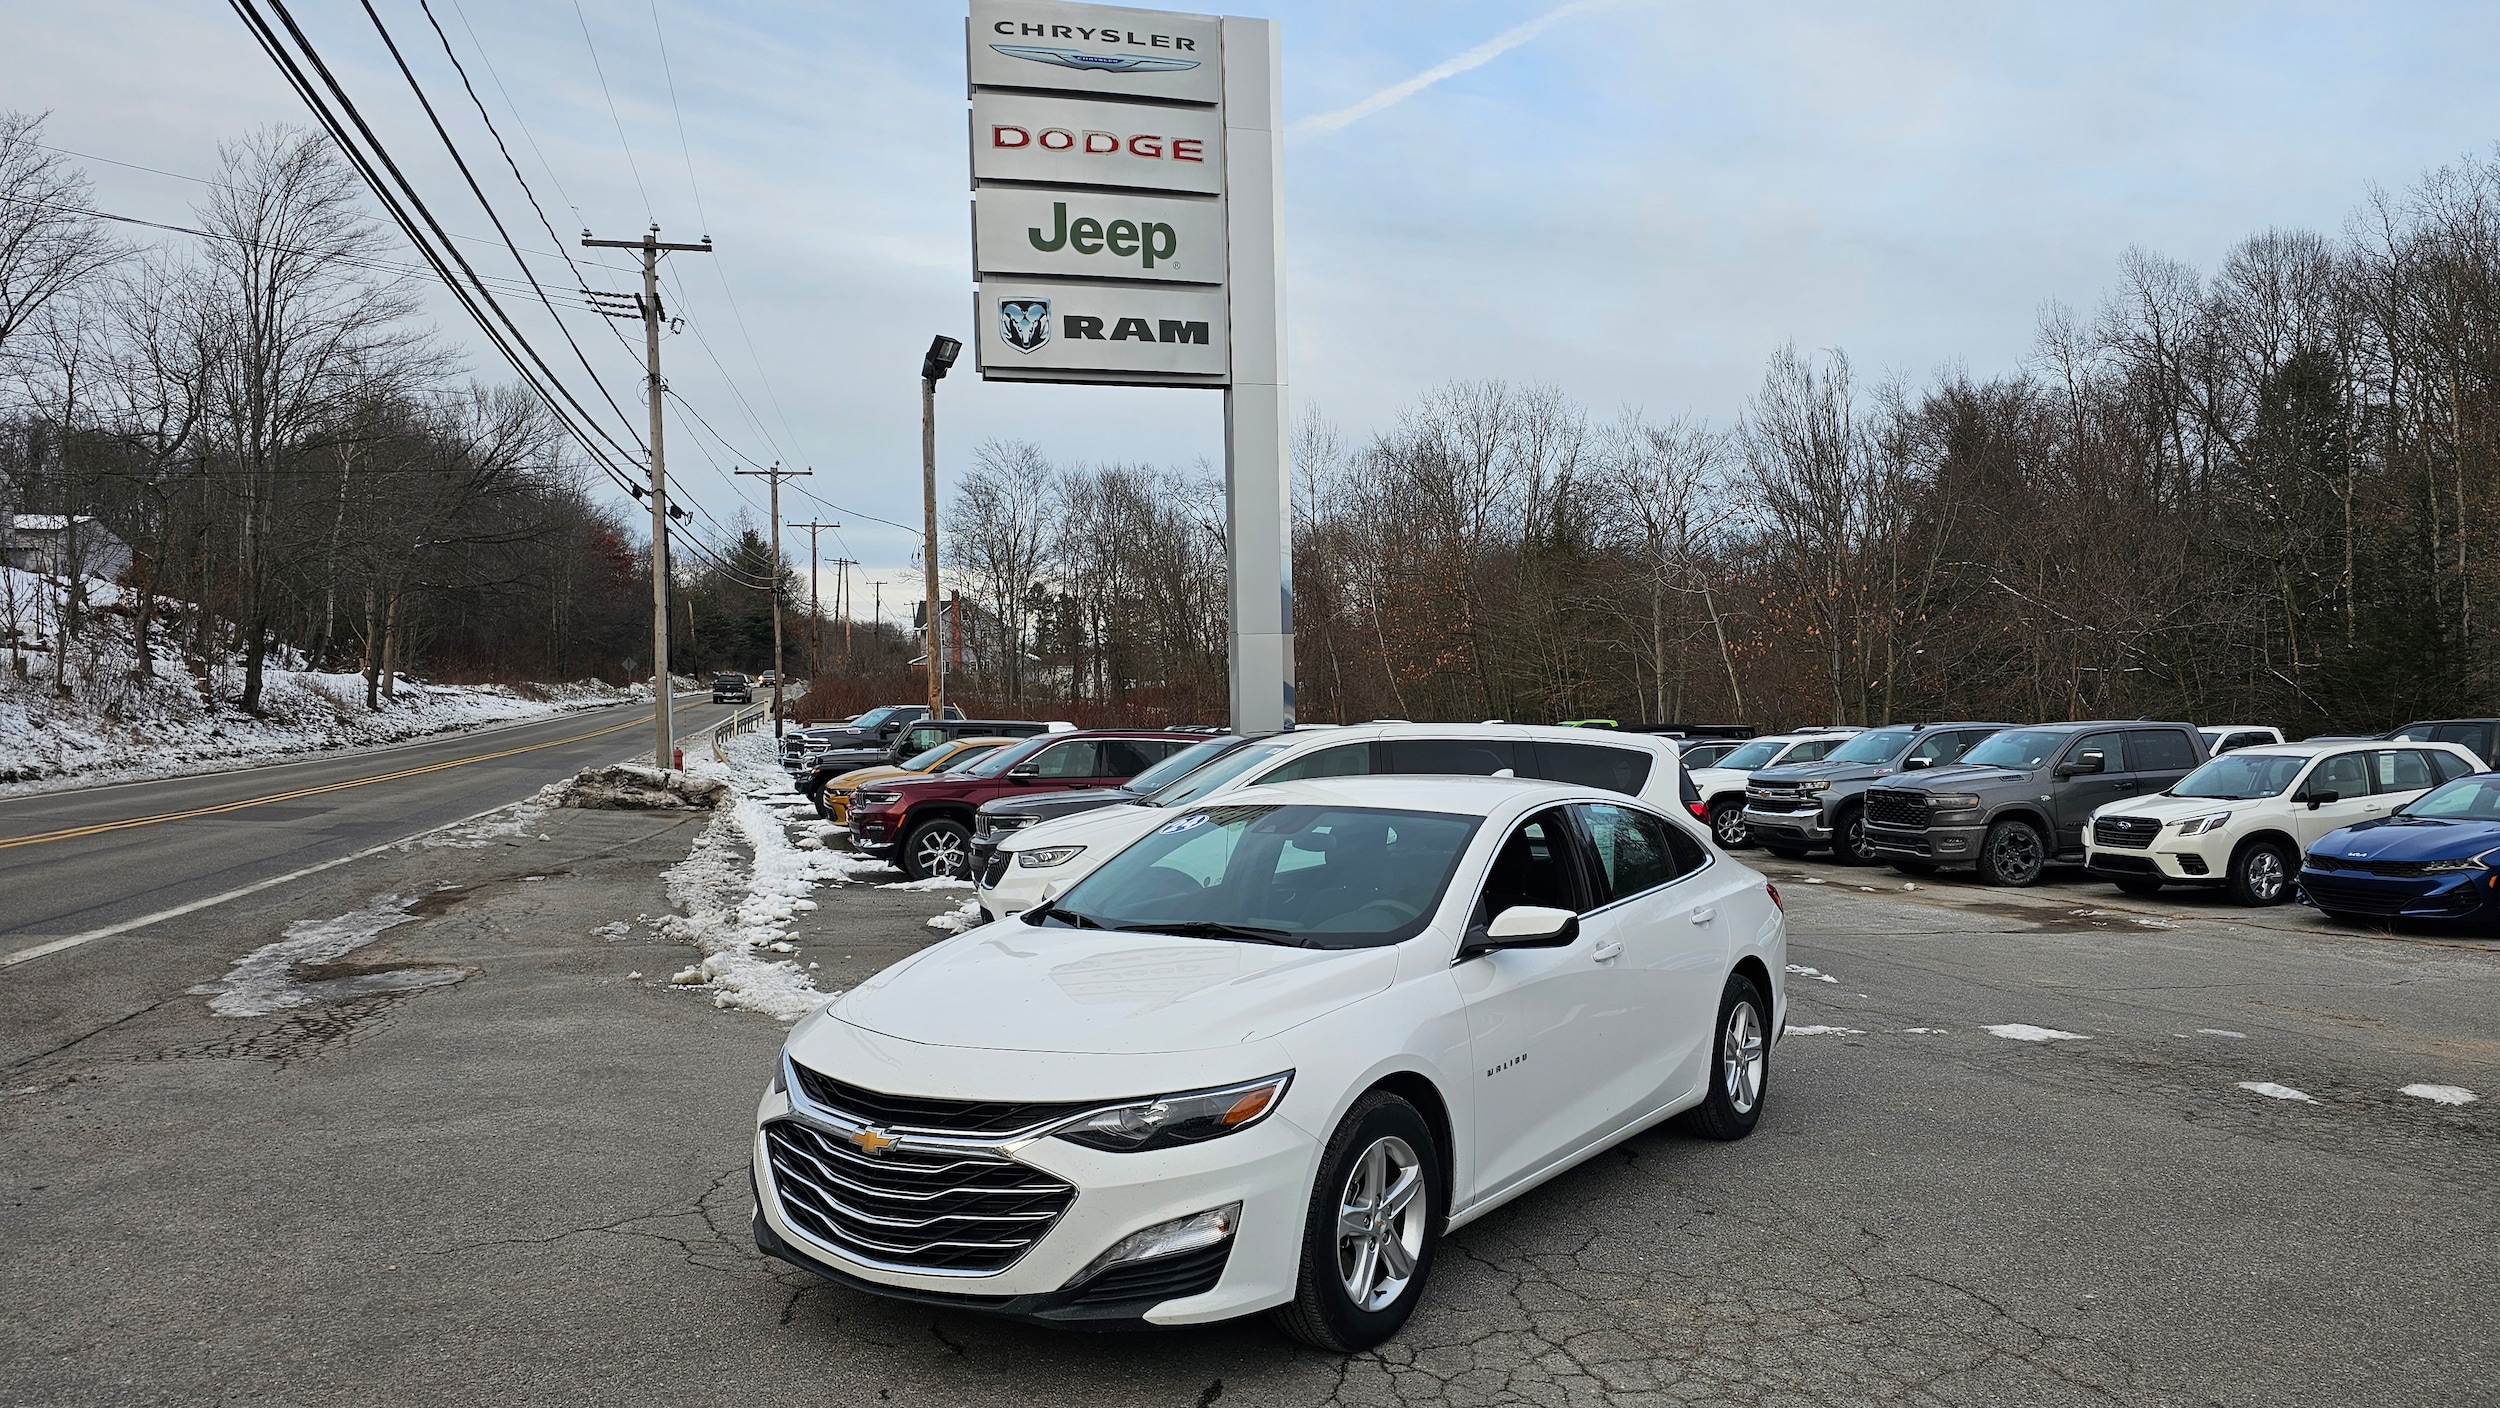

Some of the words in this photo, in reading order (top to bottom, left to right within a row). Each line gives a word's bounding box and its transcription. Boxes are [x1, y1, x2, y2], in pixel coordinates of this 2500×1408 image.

[994, 21, 1196, 51] CHRYSLER
[992, 124, 1204, 163] DODGE
[1028, 202, 1177, 269] Jeep
[1064, 315, 1209, 345] RAM
[1486, 1053, 1528, 1077] MALIBU
